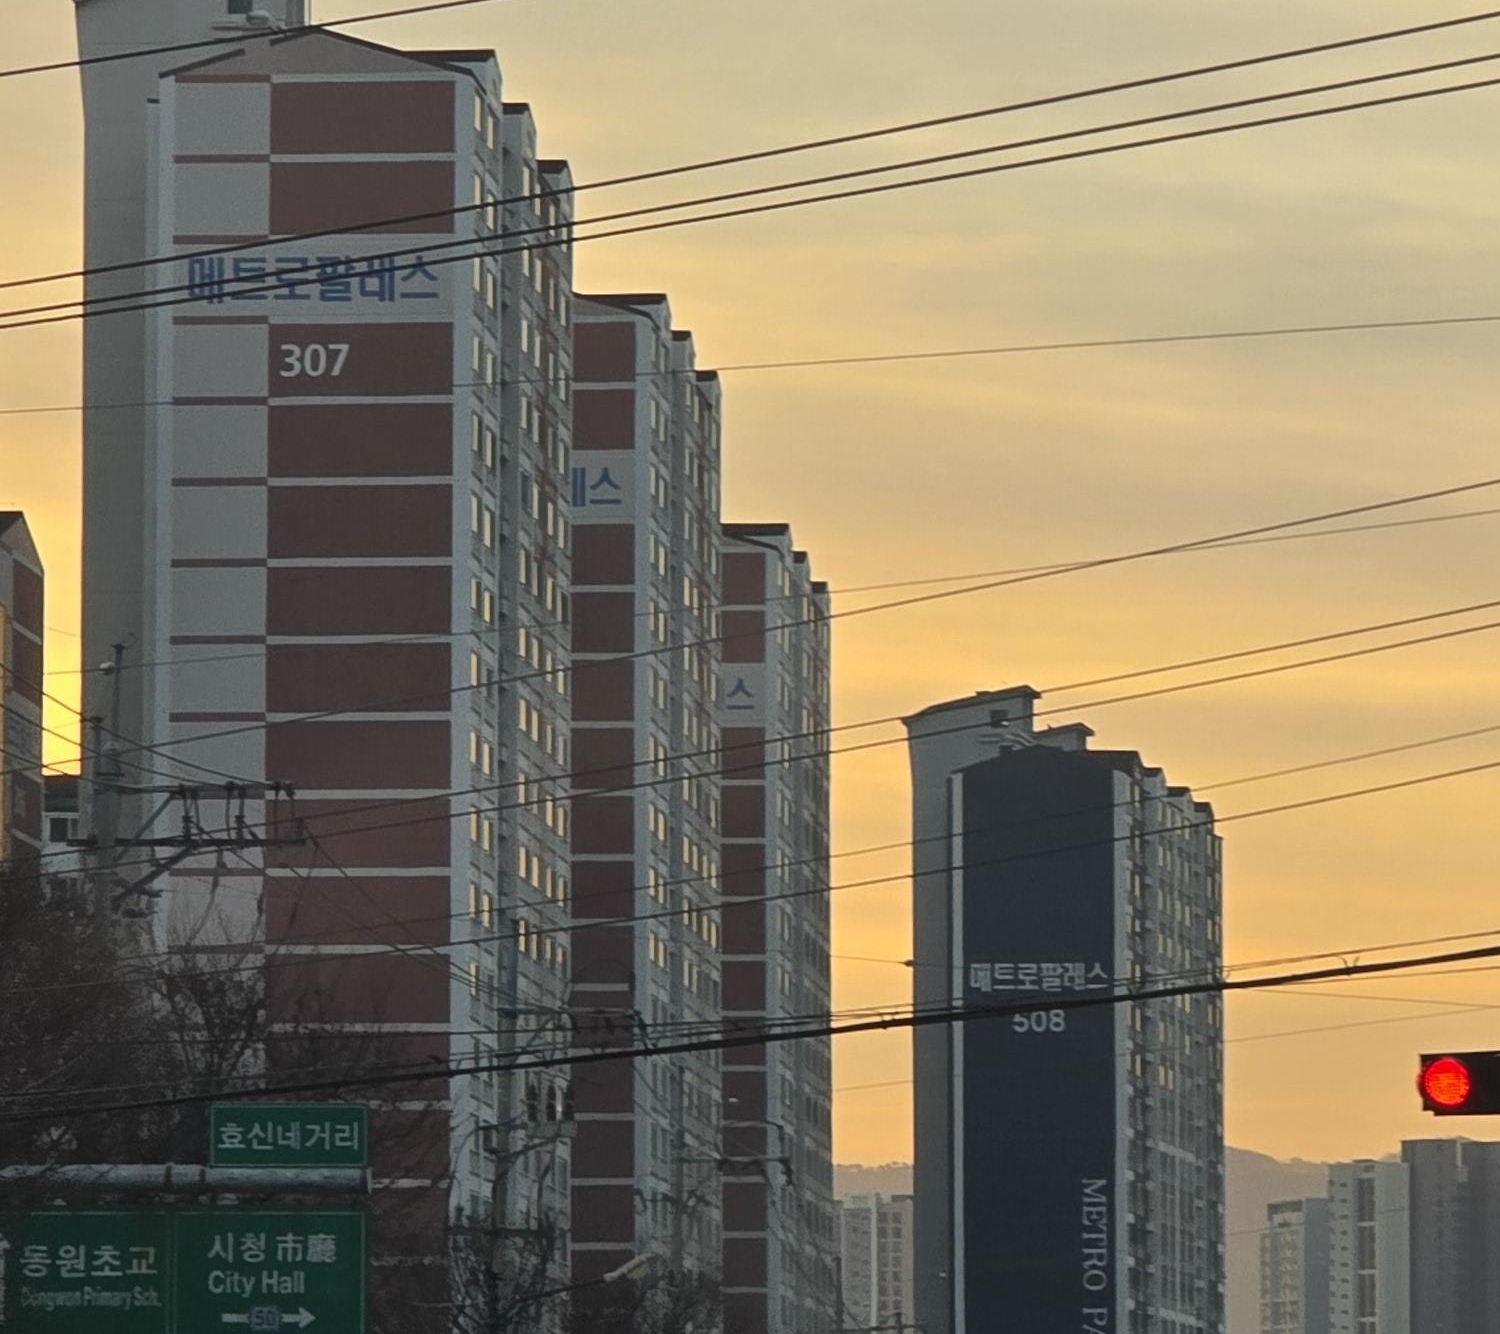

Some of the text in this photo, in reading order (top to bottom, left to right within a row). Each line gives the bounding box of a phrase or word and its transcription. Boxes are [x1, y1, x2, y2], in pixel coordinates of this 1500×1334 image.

[188, 255, 438, 304] 메트로팔레스
[279, 342, 350, 378] 307
[969, 961, 1109, 992] 메트로팔레스
[1012, 1009, 1066, 1033] 508
[217, 1120, 360, 1152] 효신네거리
[207, 1231, 267, 1264] 시청
[1081, 1178, 1108, 1292] METRO
[18, 1243, 159, 1279] 동원초교
[207, 1269, 306, 1299] City Hall
